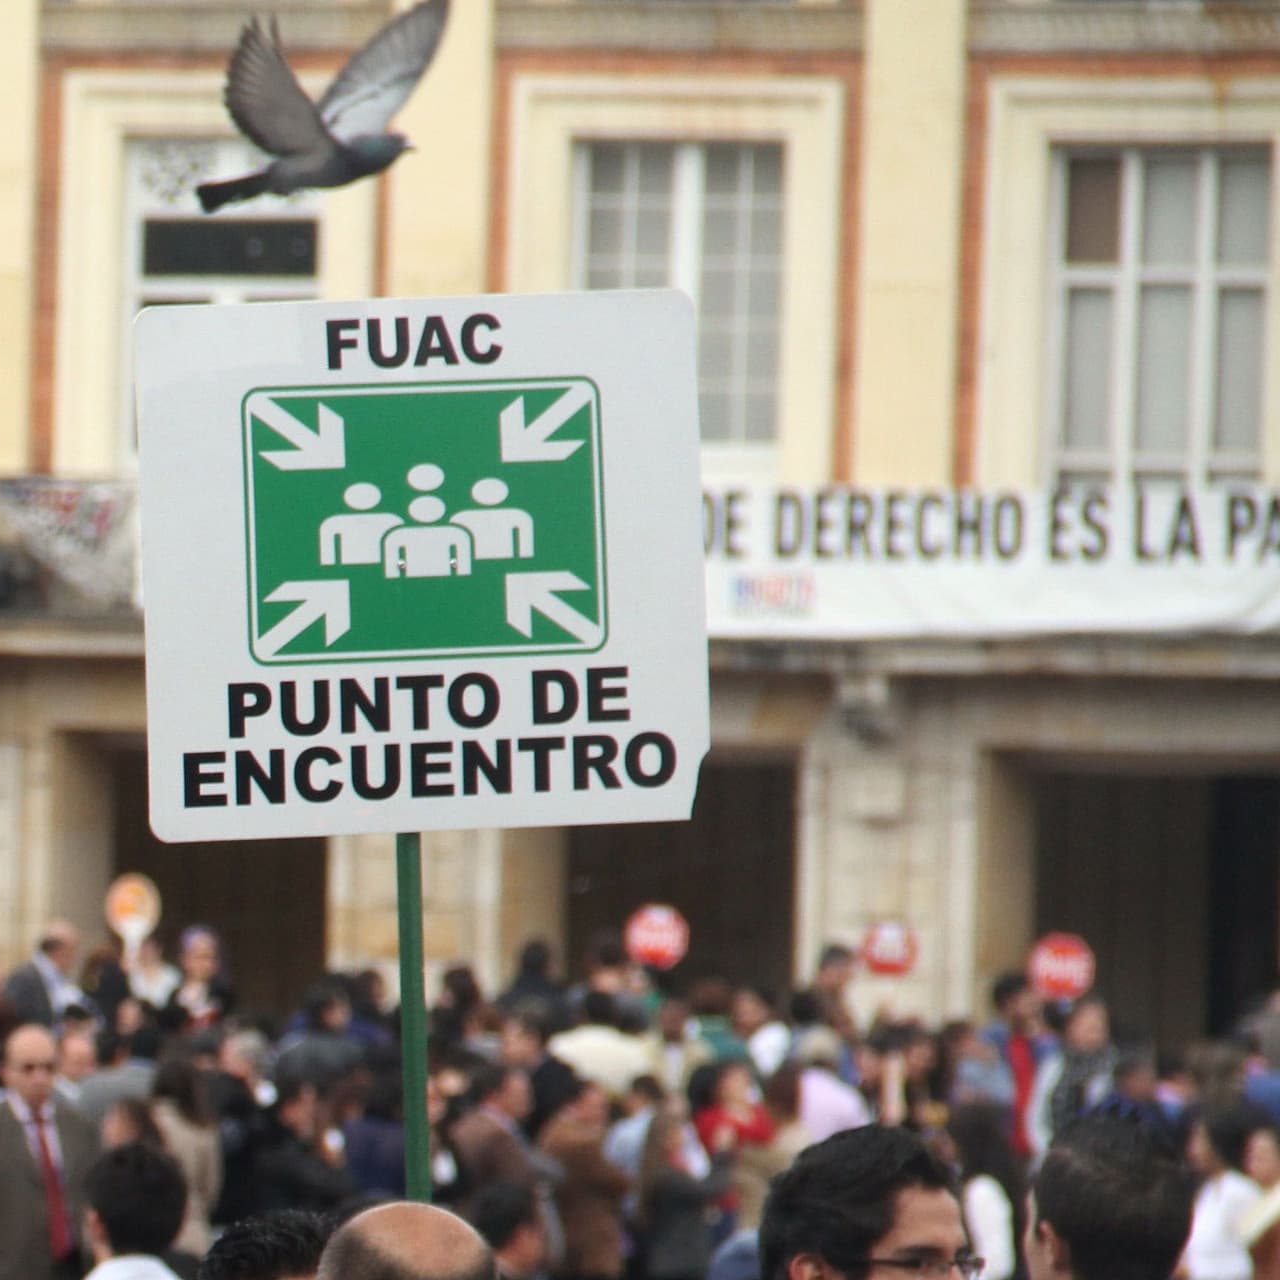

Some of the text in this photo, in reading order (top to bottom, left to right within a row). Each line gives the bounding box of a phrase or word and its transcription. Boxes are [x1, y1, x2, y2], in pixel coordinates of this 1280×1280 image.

[326, 315, 503, 369] FUAC
[774, 490, 1026, 560] DERECHO
[1049, 494, 1109, 562] ES
[1134, 494, 1201, 561] LA
[227, 666, 631, 739] PUNTO DE
[182, 732, 677, 808] ENCUENTRO
